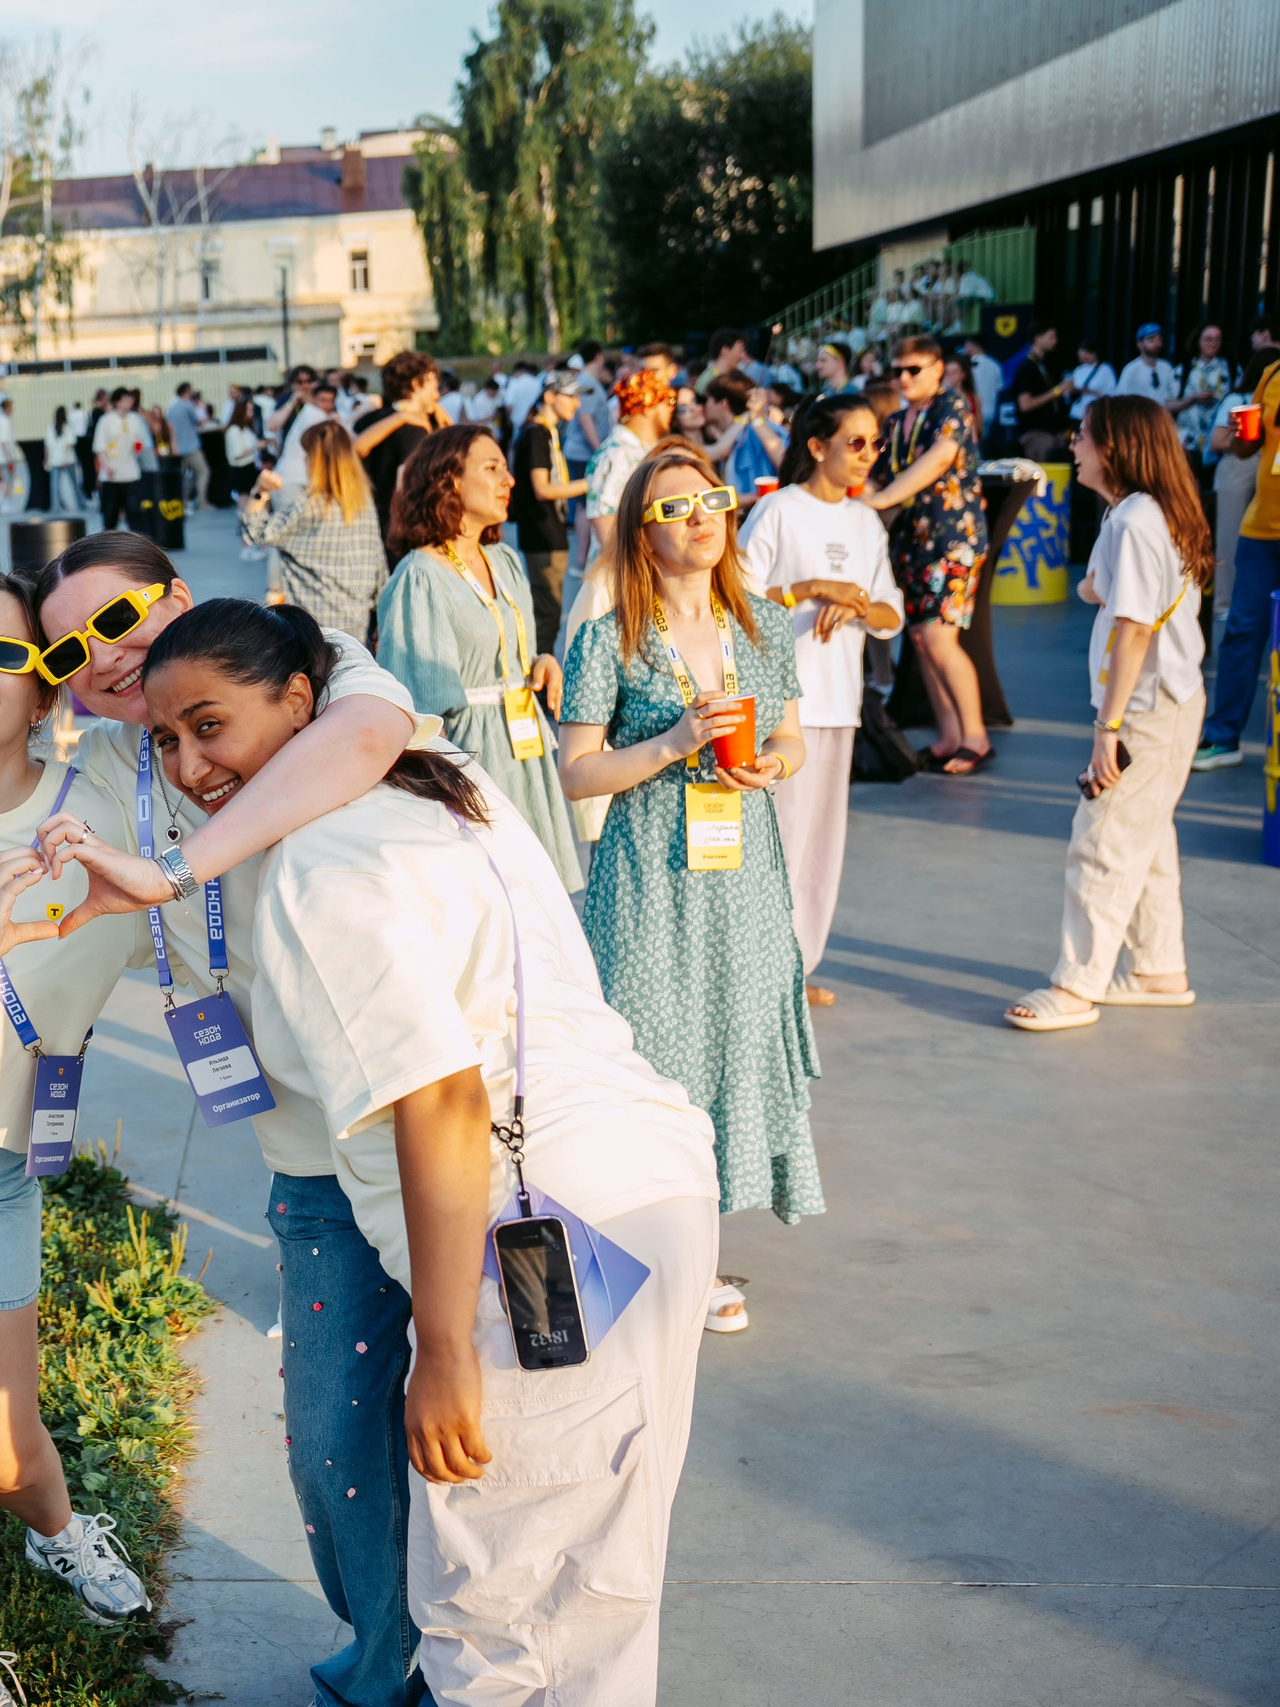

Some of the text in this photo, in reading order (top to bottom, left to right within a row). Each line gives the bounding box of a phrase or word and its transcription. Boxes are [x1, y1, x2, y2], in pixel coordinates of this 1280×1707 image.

[678, 675, 694, 704] сезо
[140, 728, 150, 772] сезо
[207, 890, 223, 940] кода
[212, 1092, 261, 1113] Организатор
